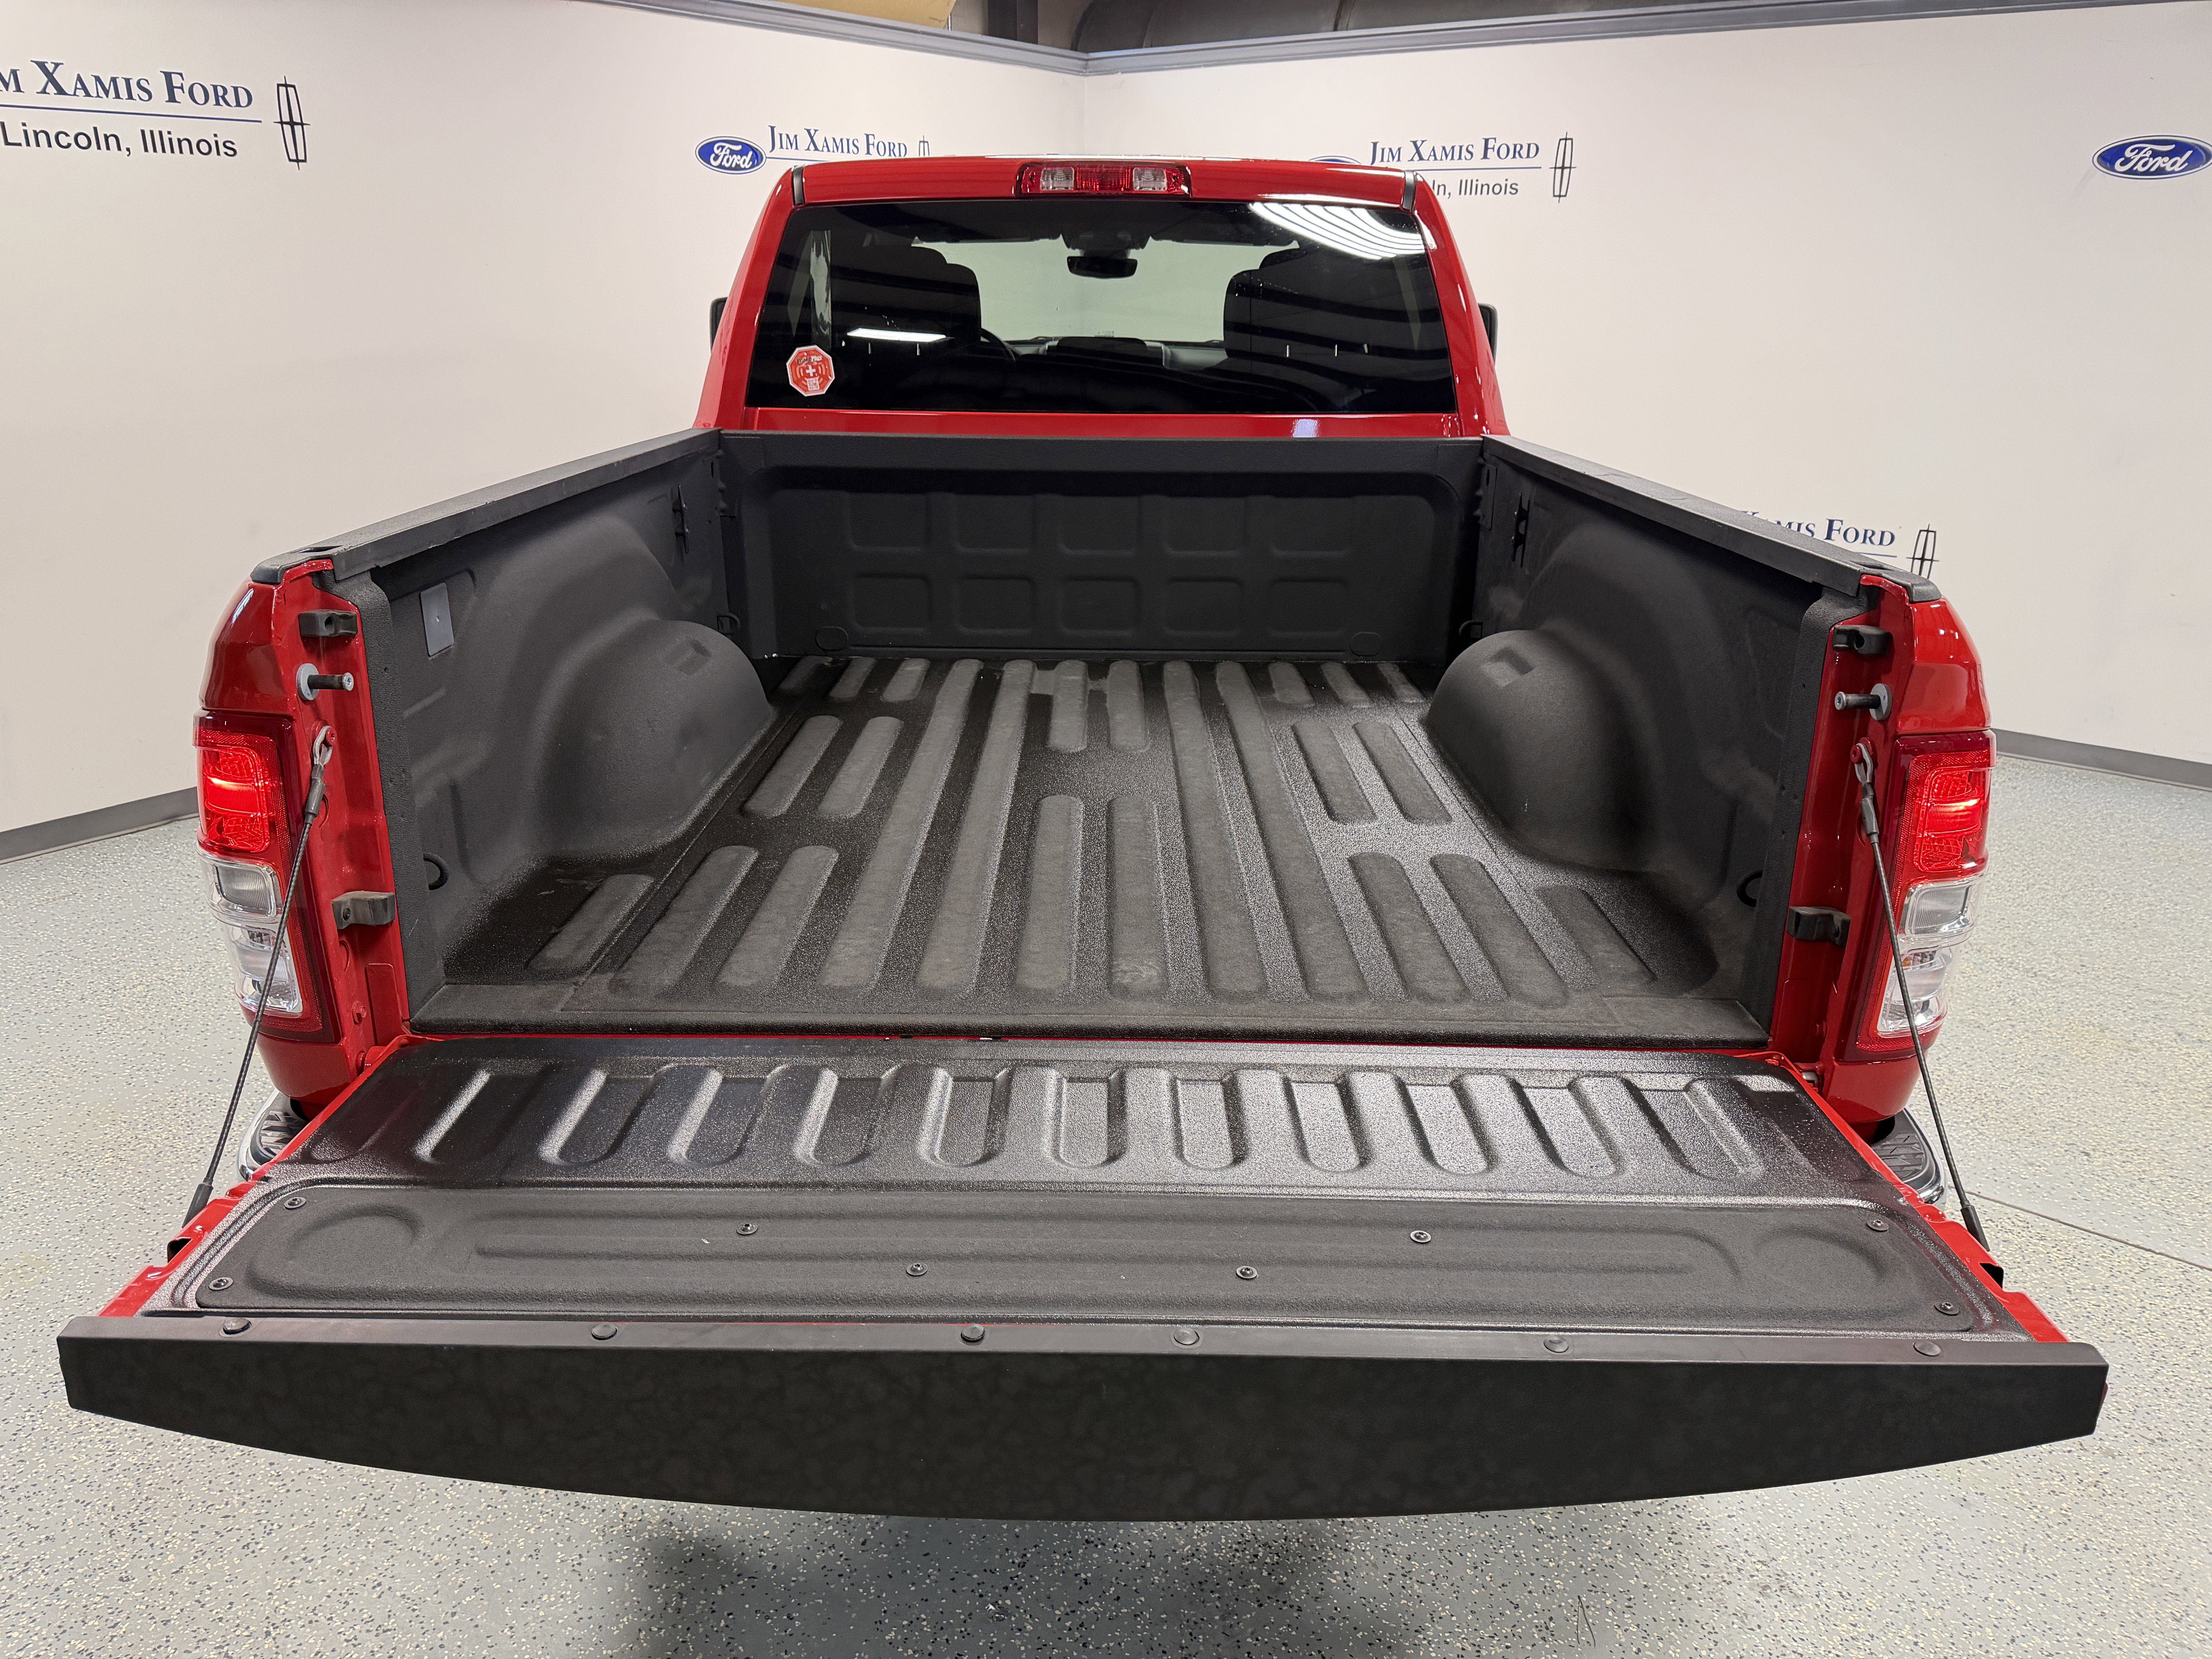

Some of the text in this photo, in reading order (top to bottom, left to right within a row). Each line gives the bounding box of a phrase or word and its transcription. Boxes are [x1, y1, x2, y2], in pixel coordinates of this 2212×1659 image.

[30, 60, 153, 102] XAMIS
[160, 70, 253, 108] FORD
[0, 121, 237, 157] Lincoln, Illinois
[768, 125, 907, 157] JIM XAMIS FORD
[1370, 137, 1539, 165] JIM XAMIS FORD
[710, 142, 753, 168] Ford
[2115, 144, 2193, 172] Ford
[1459, 179, 1518, 195] Illinois
[1824, 519, 1895, 546] FORD
